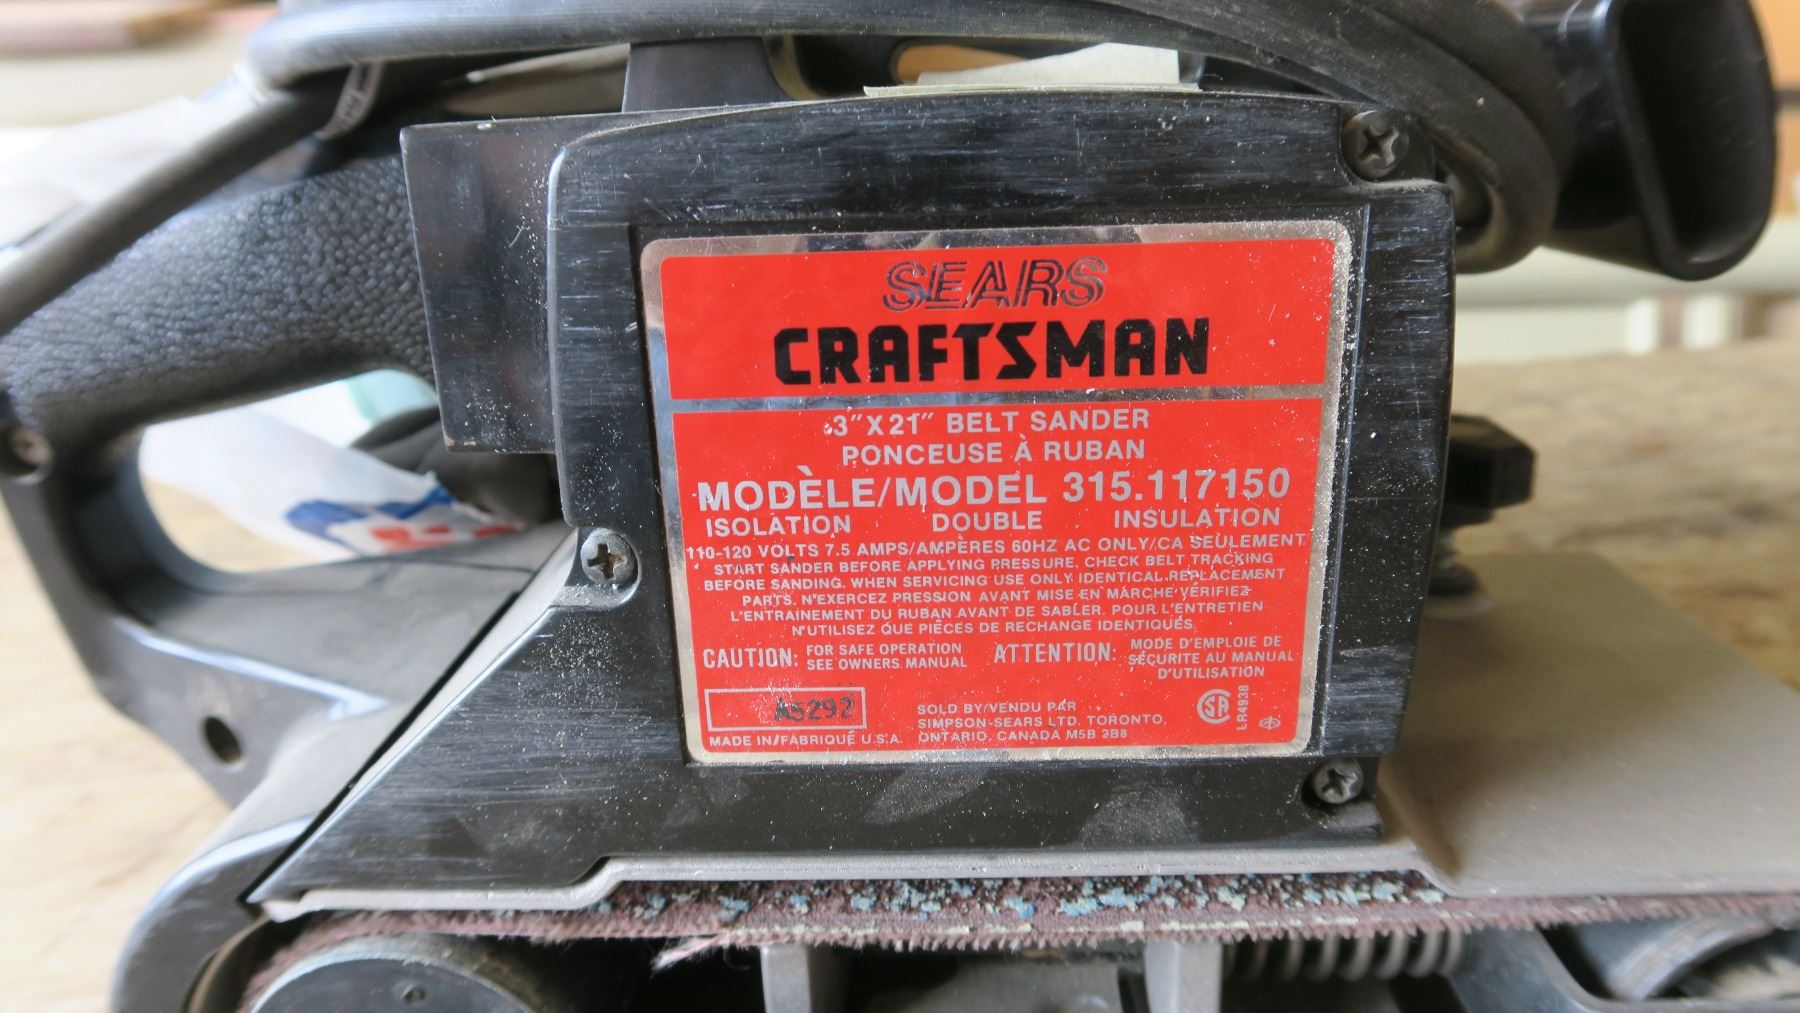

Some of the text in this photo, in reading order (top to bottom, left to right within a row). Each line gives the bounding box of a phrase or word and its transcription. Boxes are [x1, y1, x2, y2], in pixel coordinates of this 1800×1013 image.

[882, 256, 1108, 311] SEARS
[774, 317, 1208, 385] CRAFTSMAN
[946, 411, 1018, 433] BELT
[1030, 408, 1149, 431] SANDER
[842, 432, 1145, 466] PONCEUSE À RUBAN
[699, 465, 1290, 511] MODÈLE/MODEL 315.117150
[706, 507, 1280, 536] ISOLATION DOUBLE INSULATION
[686, 546, 752, 559] 110-120
[758, 544, 819, 558] VOLTS
[825, 544, 850, 556] 7.5
[1011, 539, 1057, 553] 60HZ
[1064, 538, 1091, 552] AC
[1098, 536, 1184, 551] ONLY/CA
[1190, 533, 1304, 549] SEULEMENT
[714, 563, 765, 576] START
[770, 562, 833, 574] SANDER
[839, 560, 901, 573] BEFORE
[907, 559, 985, 571] APPLYING
[1085, 555, 1140, 568] CHECK
[1145, 554, 1184, 566] BELT
[1191, 552, 1274, 565] TRACKING
[704, 568, 1285, 591] BEFORE SANDING. WHEN SERVICING USE ONLY IDENTICAL REPLACEMENT
[742, 595, 796, 606] PARTS.
[892, 591, 971, 604] PRESSION
[979, 590, 1030, 602] AVANT
[1037, 588, 1073, 601] MISE
[1080, 588, 1100, 599] EN
[871, 609, 892, 620] DU
[898, 607, 951, 619] RUBAN
[957, 606, 1009, 618] AVANT
[1015, 606, 1035, 617] DE
[1112, 603, 1156, 616] POUR
[1162, 601, 1264, 615] L'ENTRETIEN
[881, 623, 913, 635] QUE
[980, 622, 1000, 633] DE
[1005, 619, 1092, 633] RECHANGE
[806, 643, 962, 657] FOR SAFE OPERATION
[1131, 635, 1281, 650] MODE D'EMPLOIE DE
[703, 647, 798, 669] CAUTION:
[993, 642, 1116, 664] ATTENTION:
[1205, 652, 1226, 663] AU
[1232, 650, 1294, 663] MANUAL
[807, 656, 967, 671] SEE OWNERS MANUAL
[1158, 666, 1265, 680] D'UTILISATION
[917, 701, 1076, 715] SOLD BY/VENDU PAR
[918, 716, 1043, 729] SIMPSON-SEARS
[709, 736, 751, 747] MADE
[997, 730, 1061, 741] CANADA
[1066, 729, 1096, 740] M5B
